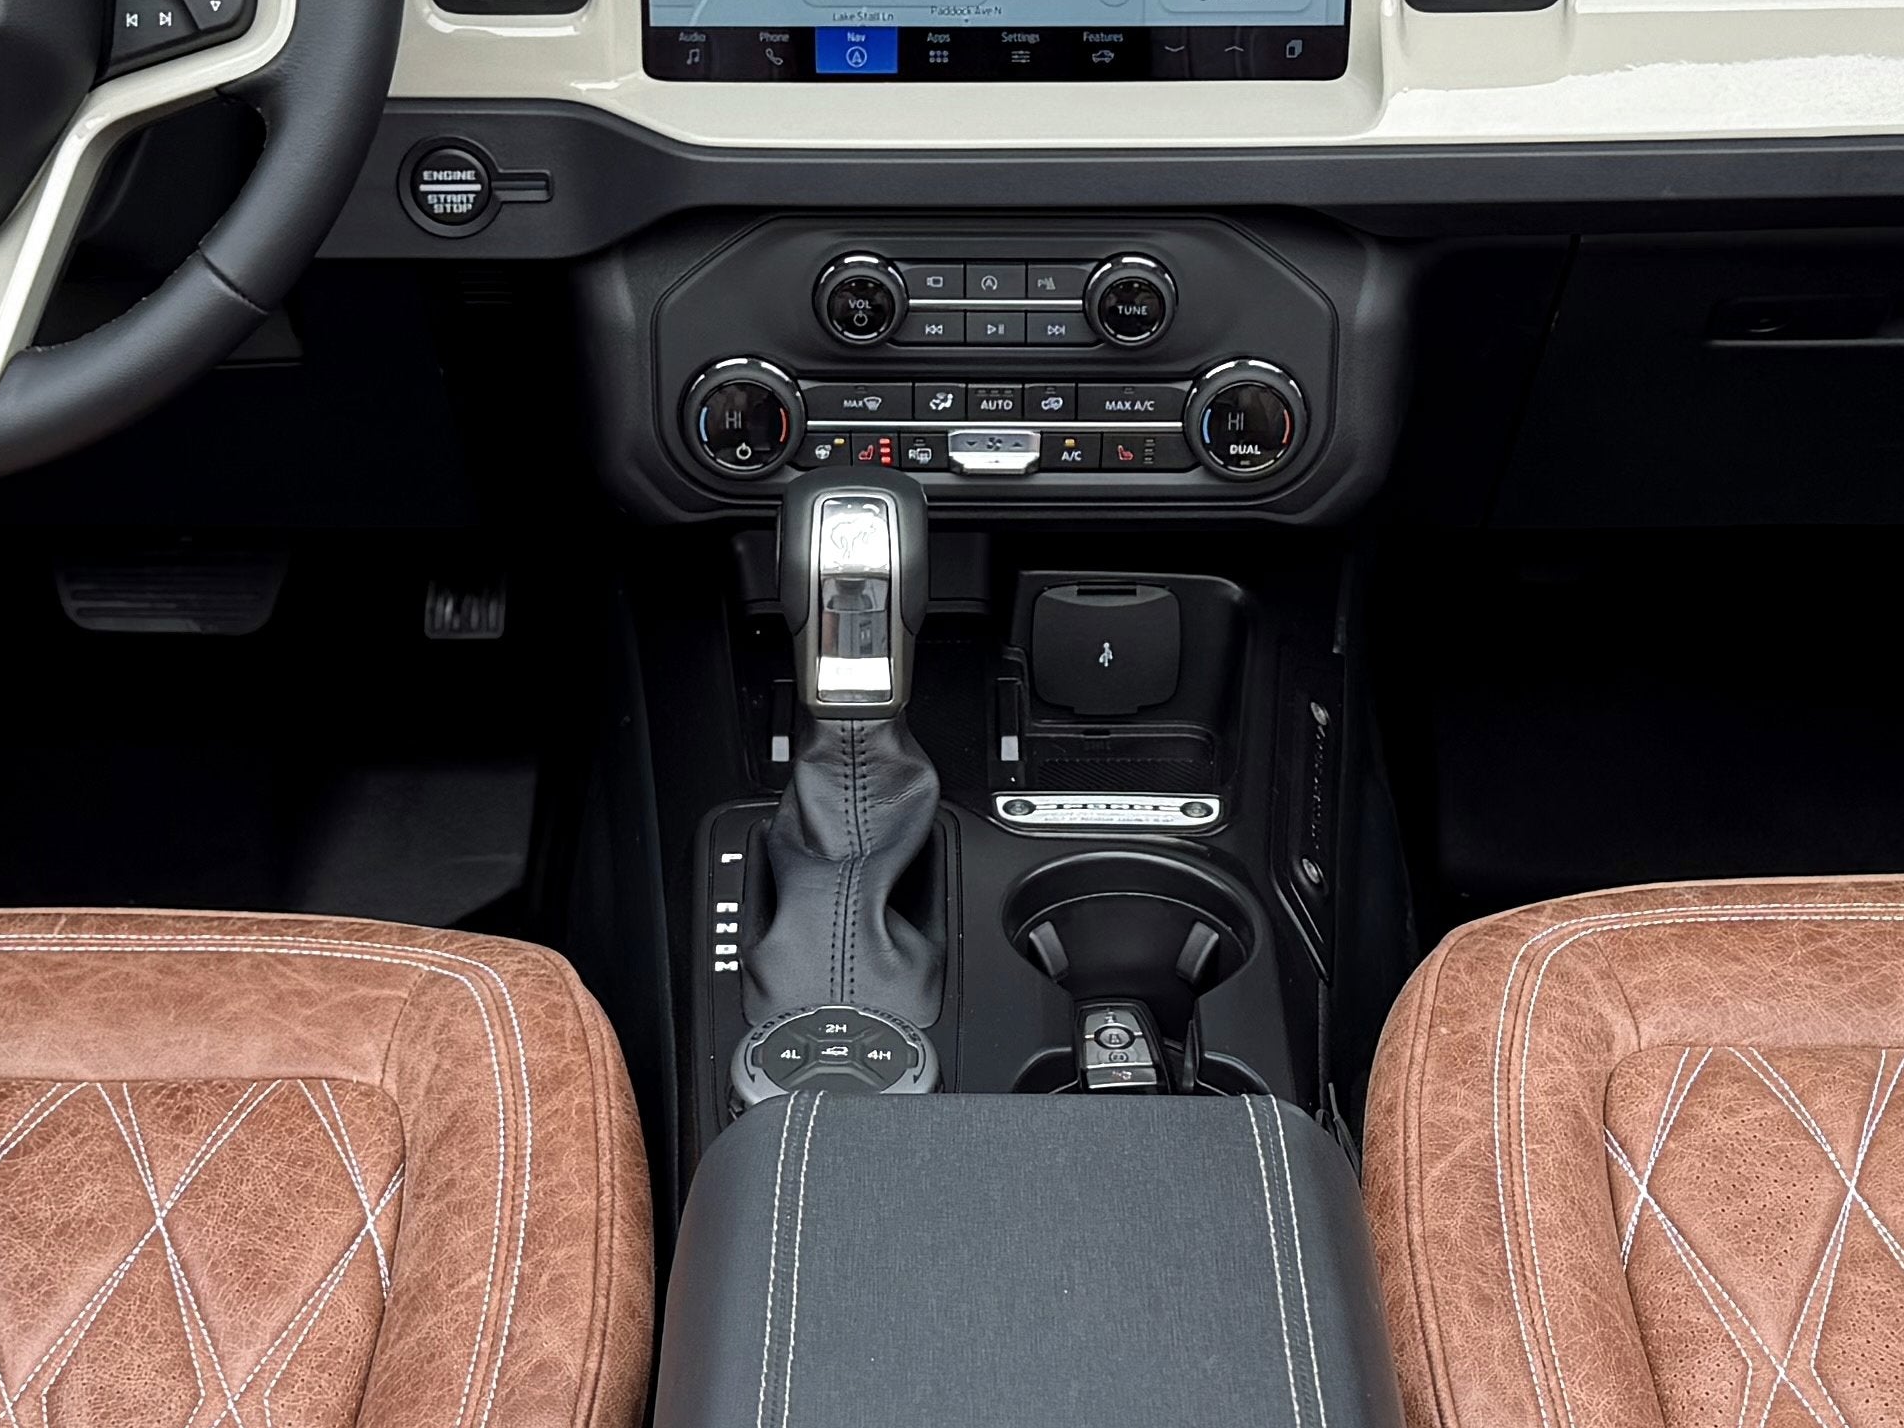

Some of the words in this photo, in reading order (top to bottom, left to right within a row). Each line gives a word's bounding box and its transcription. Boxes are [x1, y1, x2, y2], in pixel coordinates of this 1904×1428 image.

[832, 11, 855, 21] Lake
[679, 32, 706, 42] Audio
[759, 32, 789, 42] Phone
[847, 32, 866, 42] Nav
[927, 32, 951, 45] Apps
[1001, 32, 1040, 44] Settings
[1083, 32, 1123, 42] Features
[422, 170, 476, 181] ENGINE
[427, 193, 476, 204] START
[433, 203, 472, 214] STOP
[849, 300, 871, 309] VOL
[1117, 306, 1148, 315] TUNE
[980, 401, 1013, 411] AUTO
[1105, 401, 1131, 411] MAX
[1134, 400, 1155, 412] A/C
[725, 411, 742, 429] HI
[1228, 413, 1244, 431] HI
[1229, 445, 1261, 455] DUAL
[1061, 450, 1082, 462] A/C
[825, 1024, 847, 1034] 2H
[780, 1049, 801, 1060] 4L
[867, 1049, 891, 1060] 4H
